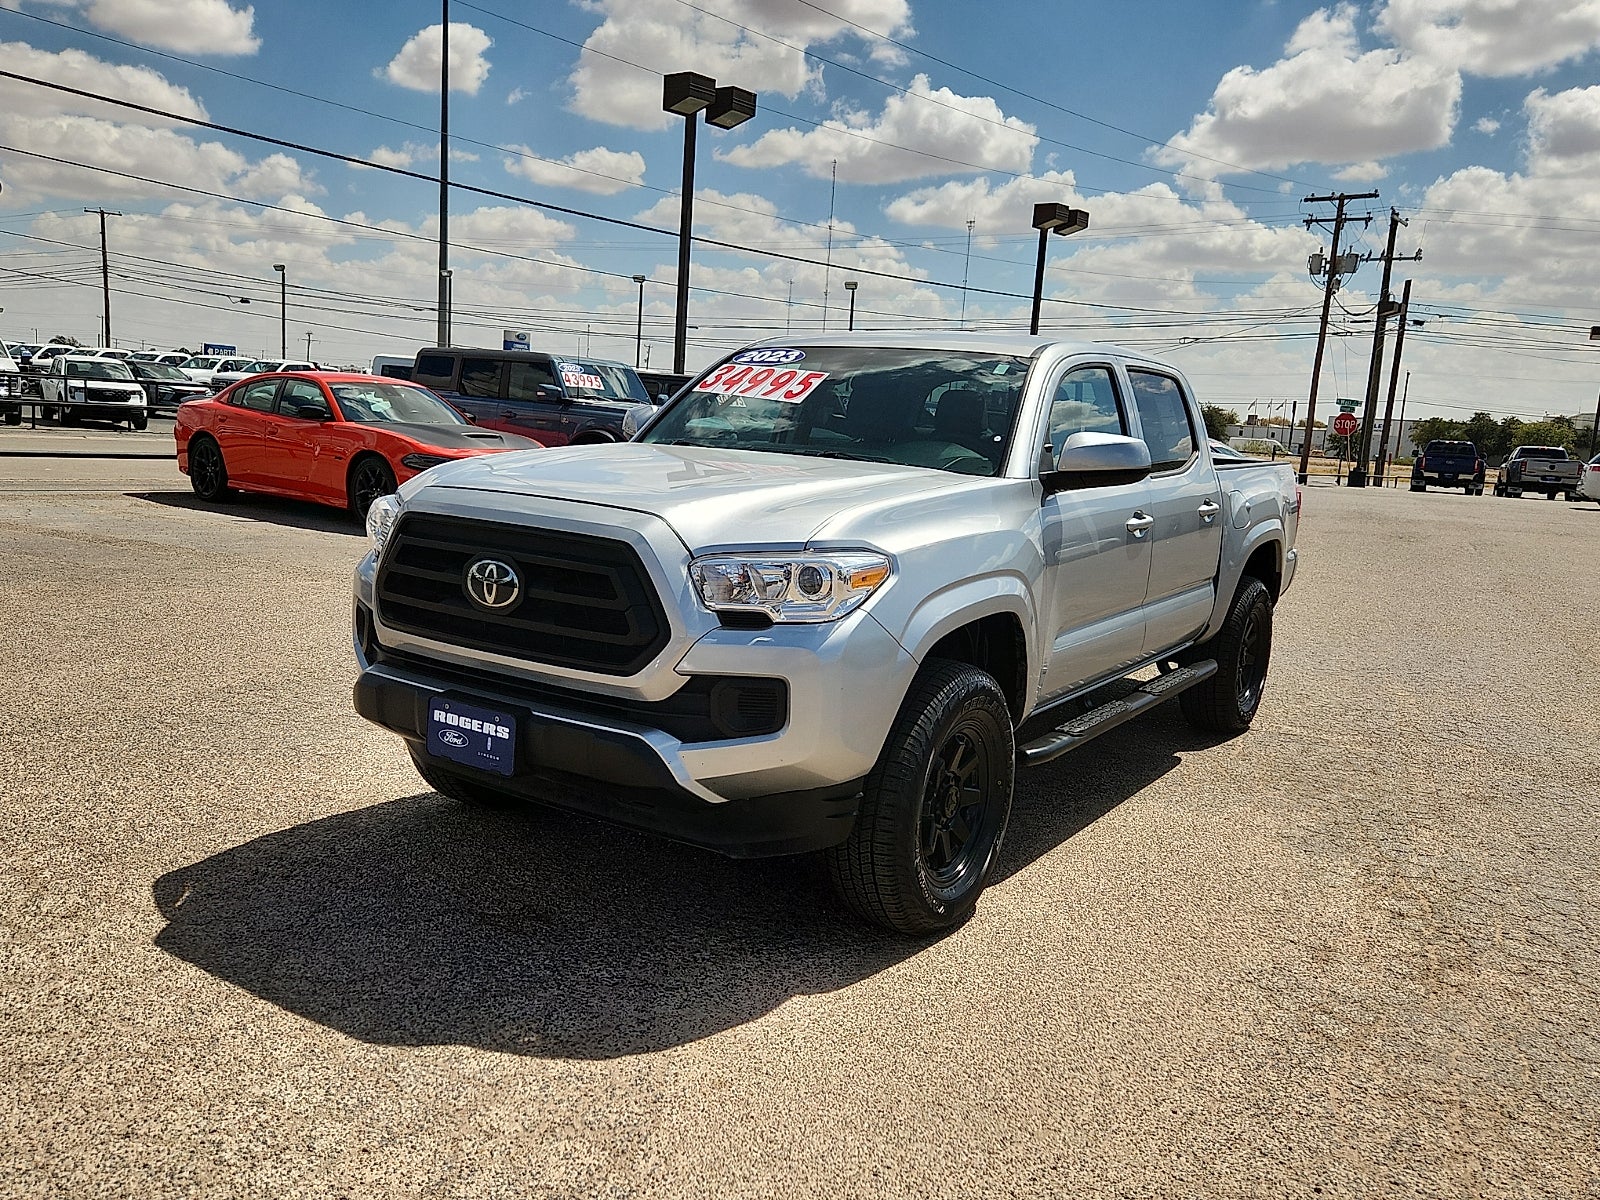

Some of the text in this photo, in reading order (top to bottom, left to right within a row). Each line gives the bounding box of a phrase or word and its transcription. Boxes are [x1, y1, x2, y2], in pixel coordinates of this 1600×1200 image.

[214, 348, 236, 356] PARTS
[743, 350, 799, 362] 2023
[564, 373, 601, 388] 43995
[699, 365, 825, 399] 34995
[1335, 419, 1356, 428] STOP
[433, 709, 509, 739] ROGERS
[443, 731, 464, 745] Ford
